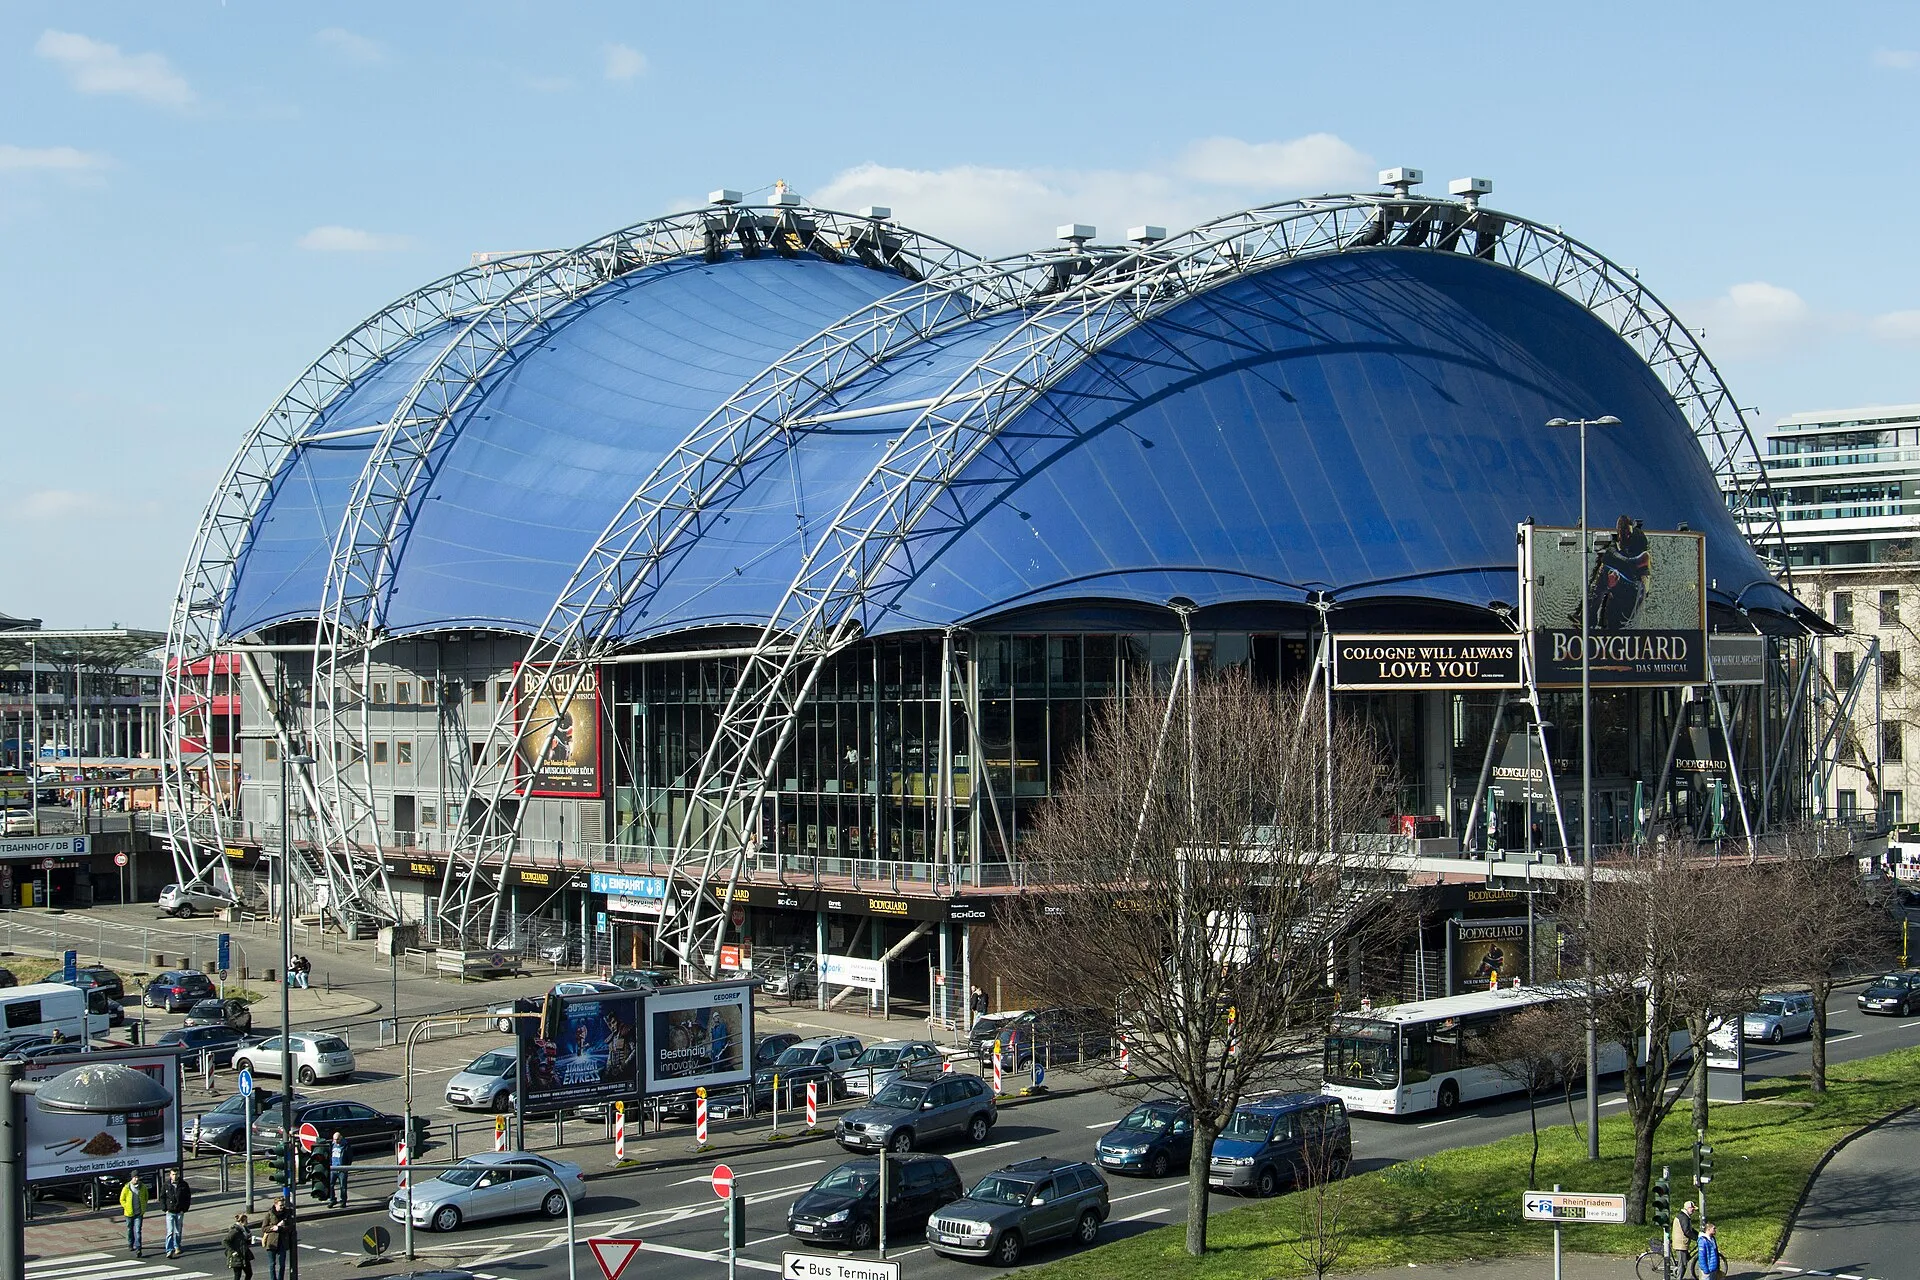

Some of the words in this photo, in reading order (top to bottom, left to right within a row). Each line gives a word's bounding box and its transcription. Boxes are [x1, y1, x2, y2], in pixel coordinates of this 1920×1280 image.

[1553, 632, 1688, 661] BODYGUARD
[1343, 647, 1416, 660] COLOGNE
[1419, 647, 1457, 659] WILL
[1460, 647, 1513, 659] ALWAYS
[1379, 662, 1432, 678] LOVE
[1436, 661, 1479, 678] YOU
[1636, 664, 1651, 672] DAS
[1654, 664, 1688, 672] MUSICAL
[1676, 759, 1727, 769] BODYGUARD
[580, 766, 594, 775] KÖLN
[1492, 767, 1543, 778] BODYGUARD
[609, 877, 645, 892] EINFAHRT
[716, 887, 749, 898] BODUARD
[1468, 891, 1518, 901] BODYGUARD
[869, 899, 908, 911] BODYGUARD
[951, 910, 985, 918] SCHÜCO
[1459, 926, 1524, 940] BODYGUARD
[714, 993, 737, 1001] GEDORE
[568, 1003, 584, 1012] 50%
[660, 1045, 706, 1060] Beständig
[565, 1060, 598, 1073] STARLIGHT
[563, 1070, 600, 1085] EXPRESS
[64, 1164, 91, 1173] Rauchen
[106, 1160, 126, 1168] tödlich
[1562, 1198, 1612, 1207] RheinTriadem
[809, 1263, 832, 1276] Bus
[837, 1266, 889, 1280] Terminal
